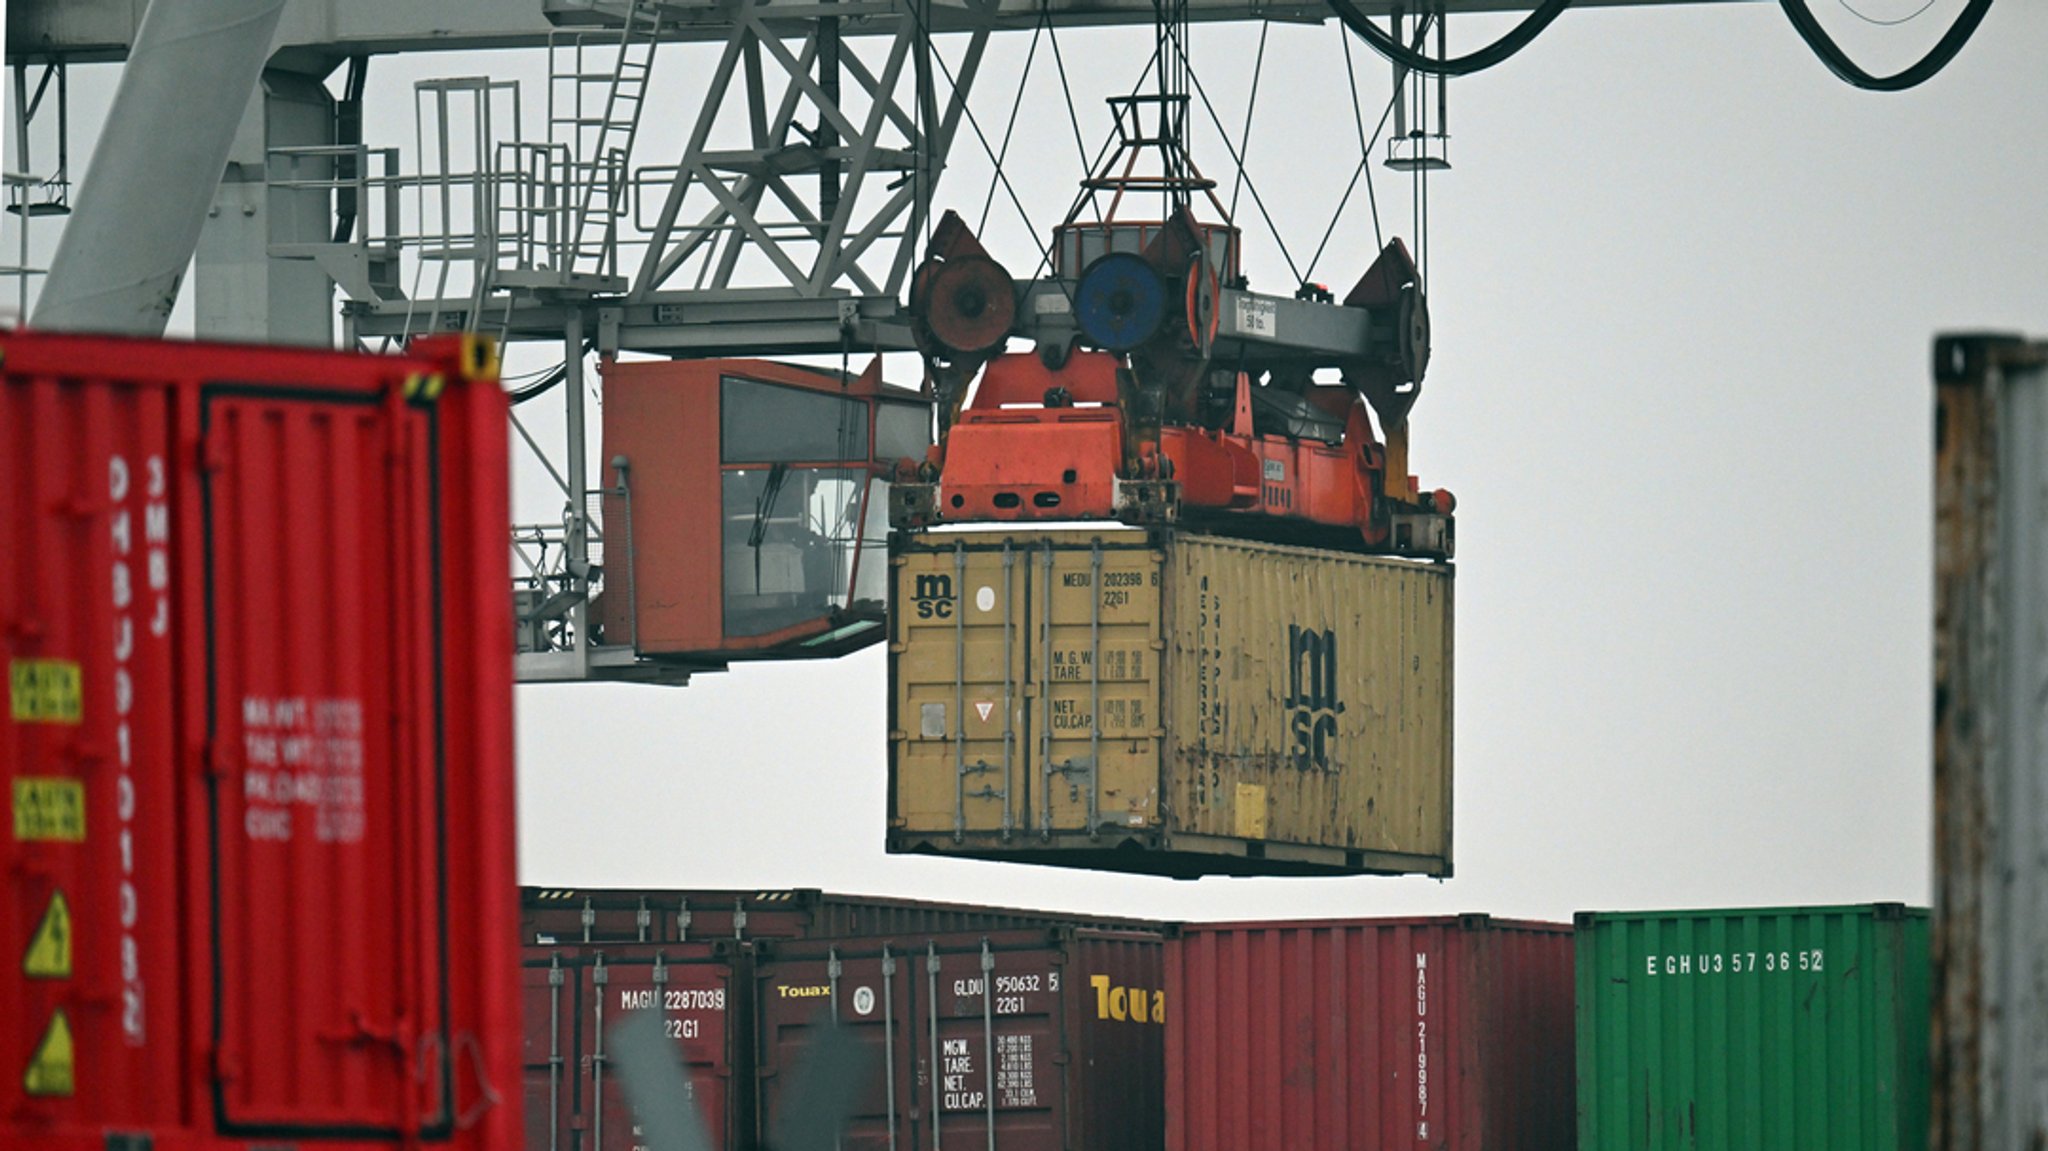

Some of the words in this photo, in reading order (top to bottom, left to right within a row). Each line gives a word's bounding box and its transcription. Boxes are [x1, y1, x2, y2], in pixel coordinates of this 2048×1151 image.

[1063, 573, 1091, 587] MEDU
[1104, 572, 1142, 587] 202398
[1151, 573, 1159, 587] 6
[1104, 592, 1129, 605] 22G1
[1054, 666, 1081, 680] TARE
[1054, 700, 1075, 714] NET
[777, 985, 831, 997] Touax
[954, 978, 984, 995] GLDU
[996, 975, 1040, 992] 950632
[1049, 973, 1059, 991] 5
[1417, 953, 1427, 1016] MAGU
[621, 990, 658, 1009] MAGU
[664, 988, 725, 1010] 2287039
[996, 997, 1025, 1014] 22G1
[664, 1020, 698, 1038] 22G1
[944, 1057, 974, 1073] TARE.
[1418, 1022, 1427, 1116] 219987
[944, 1075, 967, 1091] NET.
